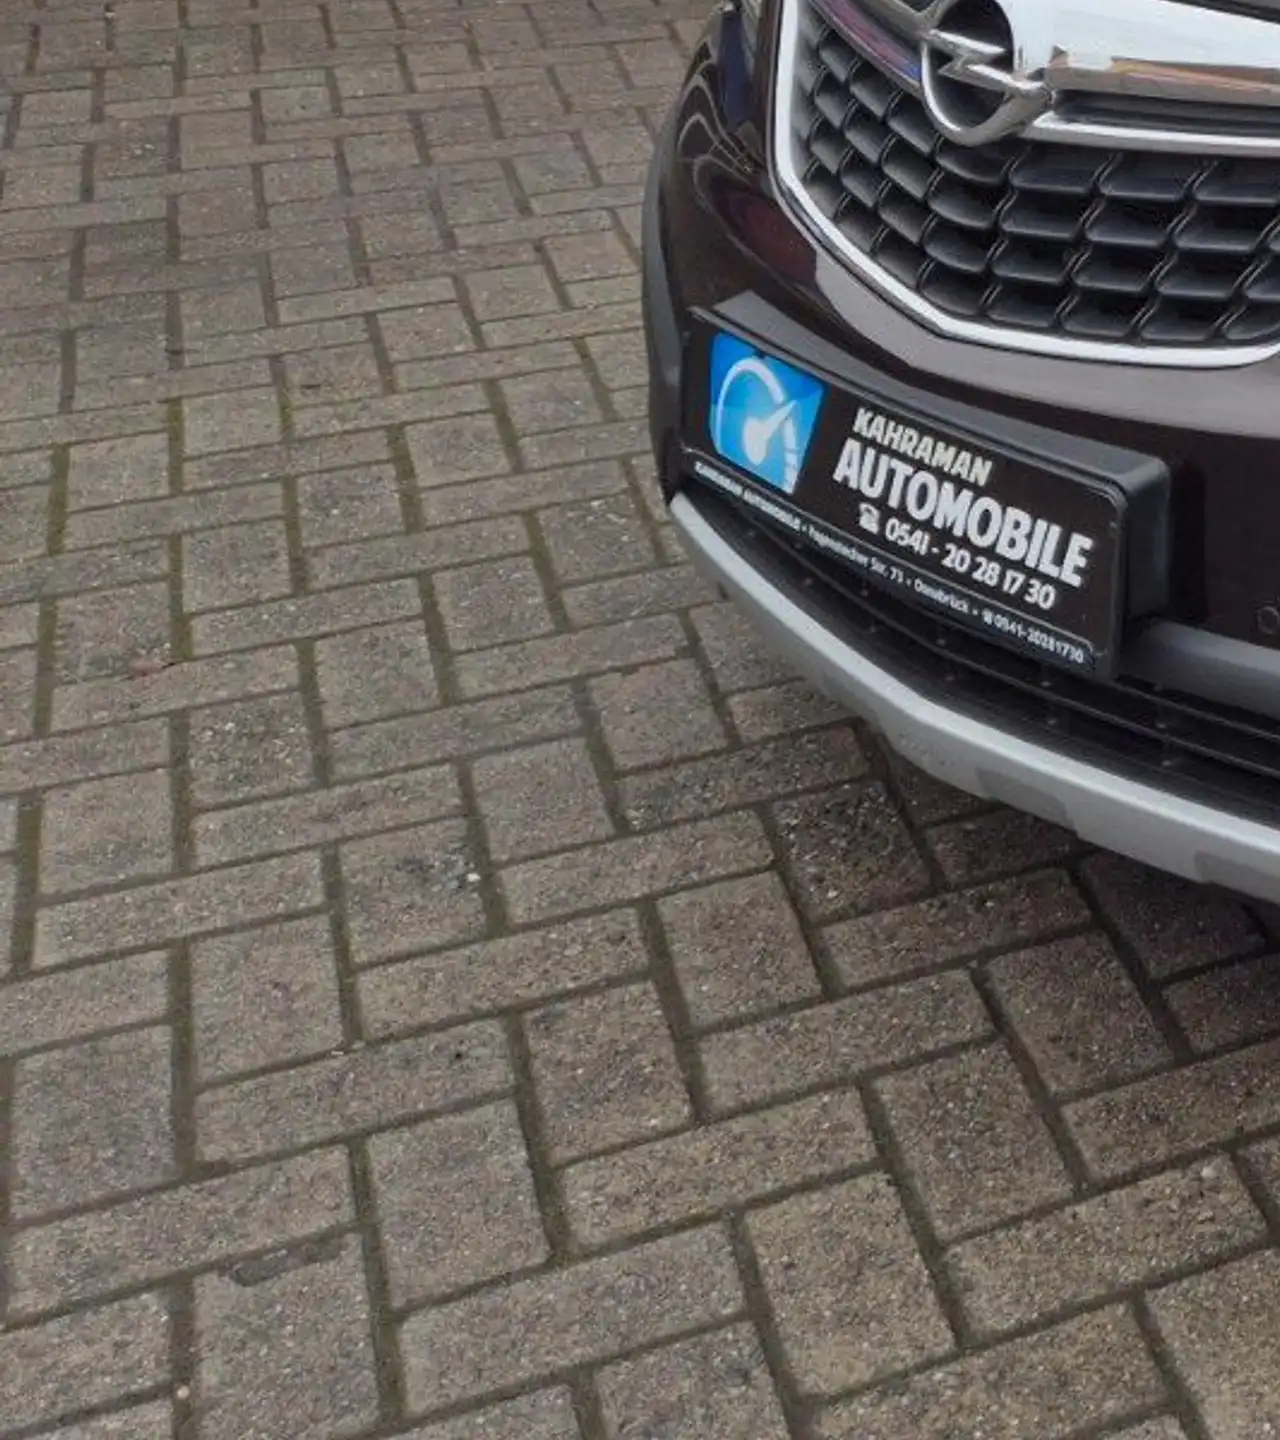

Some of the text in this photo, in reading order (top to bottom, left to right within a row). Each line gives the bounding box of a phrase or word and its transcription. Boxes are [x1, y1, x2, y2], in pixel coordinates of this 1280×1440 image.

[851, 408, 993, 488] KAHRAMAN
[833, 439, 1094, 588] AUTOMOBILE
[884, 517, 931, 556] 0541
[941, 543, 971, 574] 20
[972, 556, 1001, 587] 28
[1002, 569, 1025, 595] 17
[1024, 578, 1055, 610] 30
